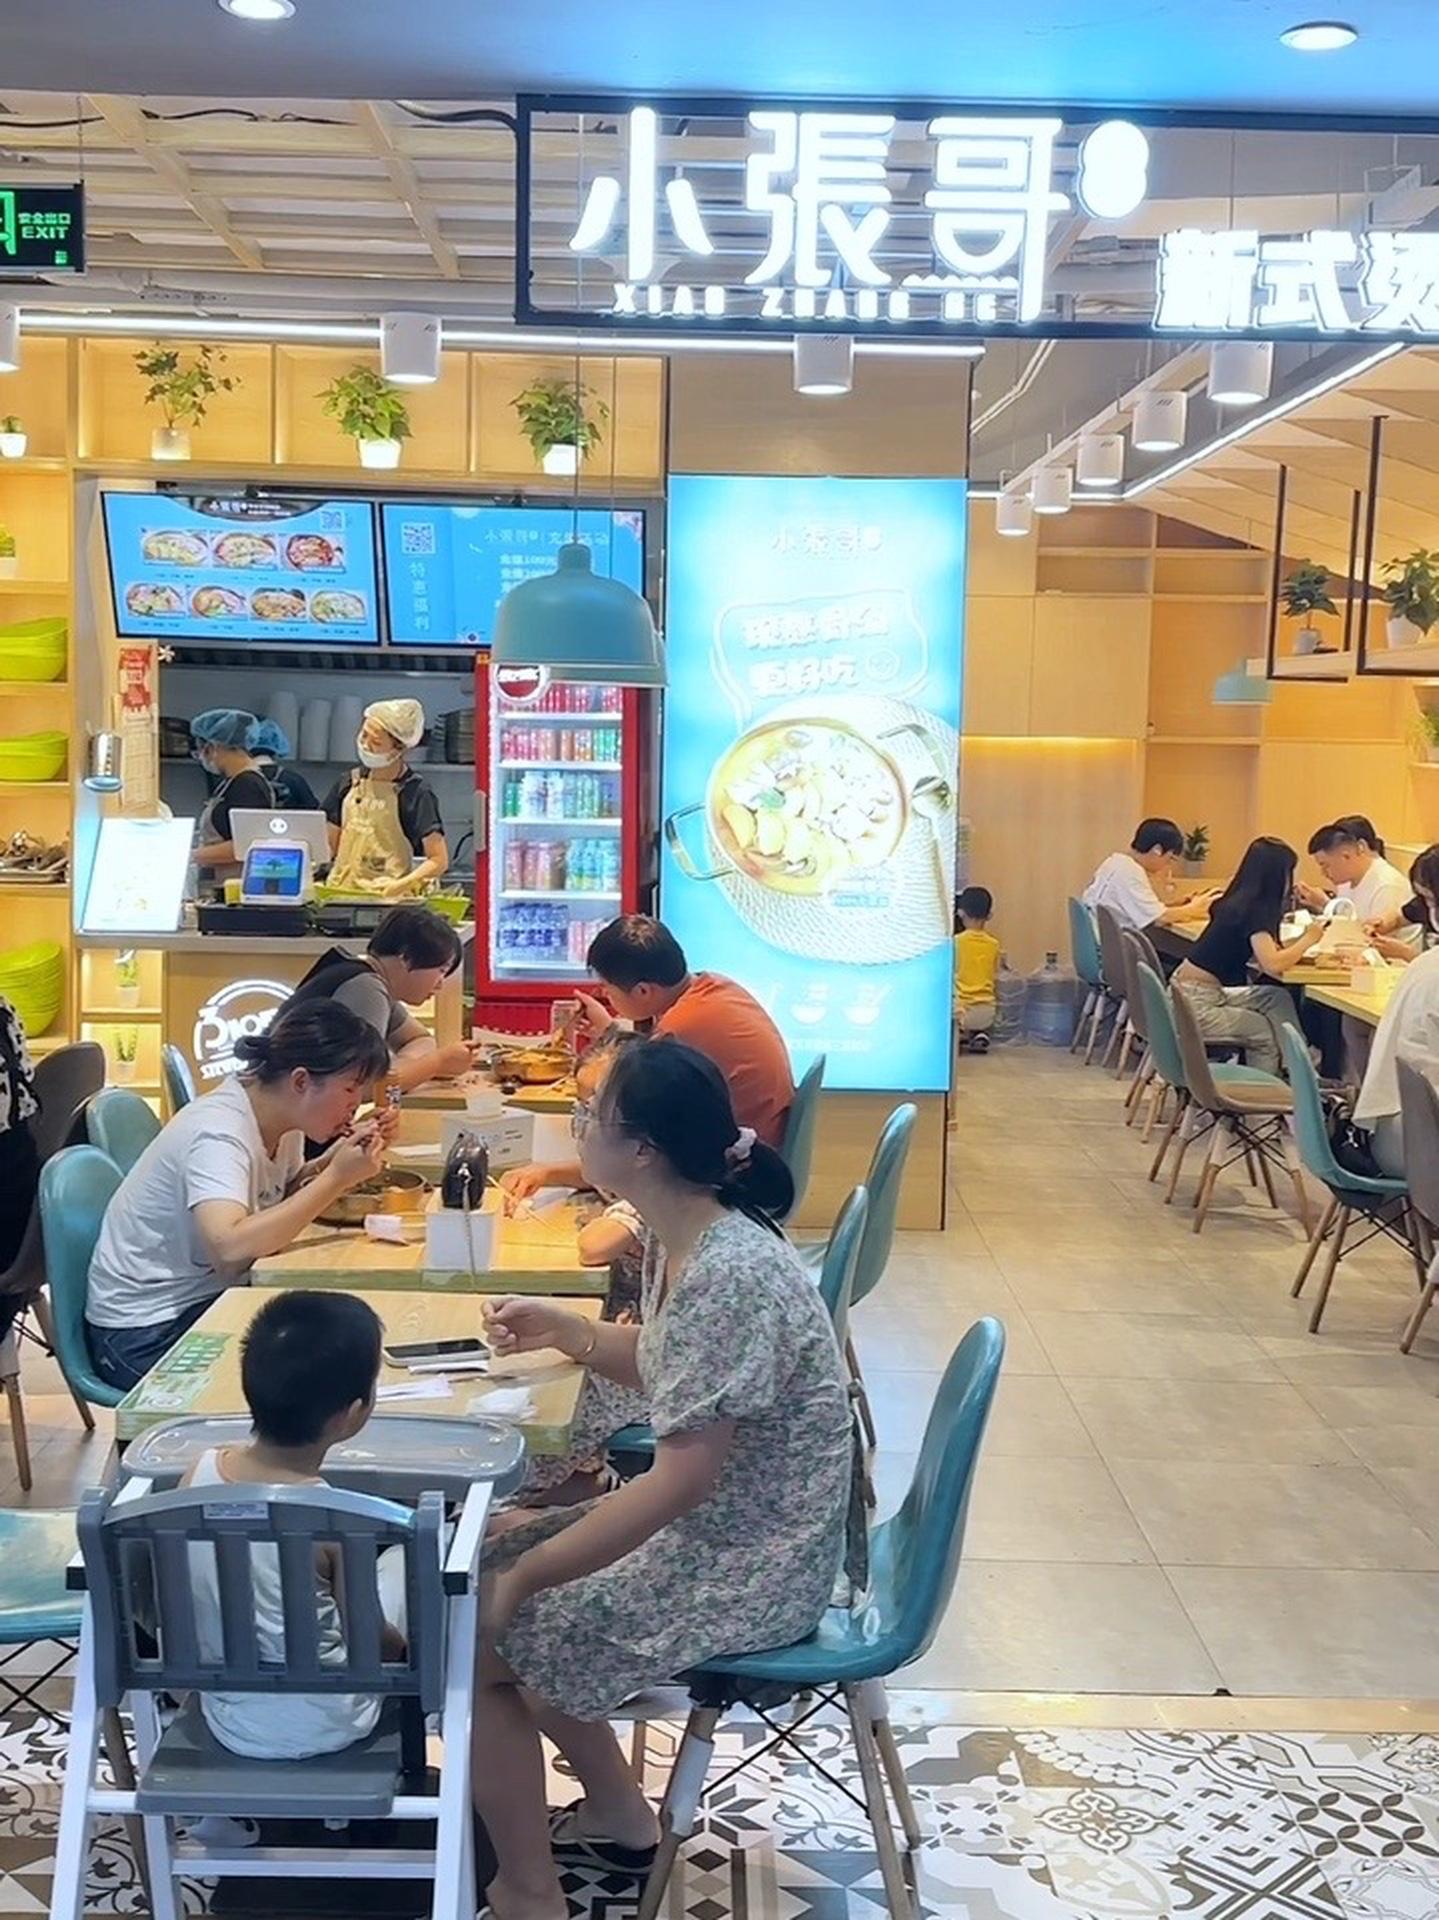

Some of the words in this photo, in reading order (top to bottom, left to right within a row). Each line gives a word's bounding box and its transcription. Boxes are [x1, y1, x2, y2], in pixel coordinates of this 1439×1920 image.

[21, 226, 68, 239] EXIT
[569, 106, 1072, 322] 小張哥
